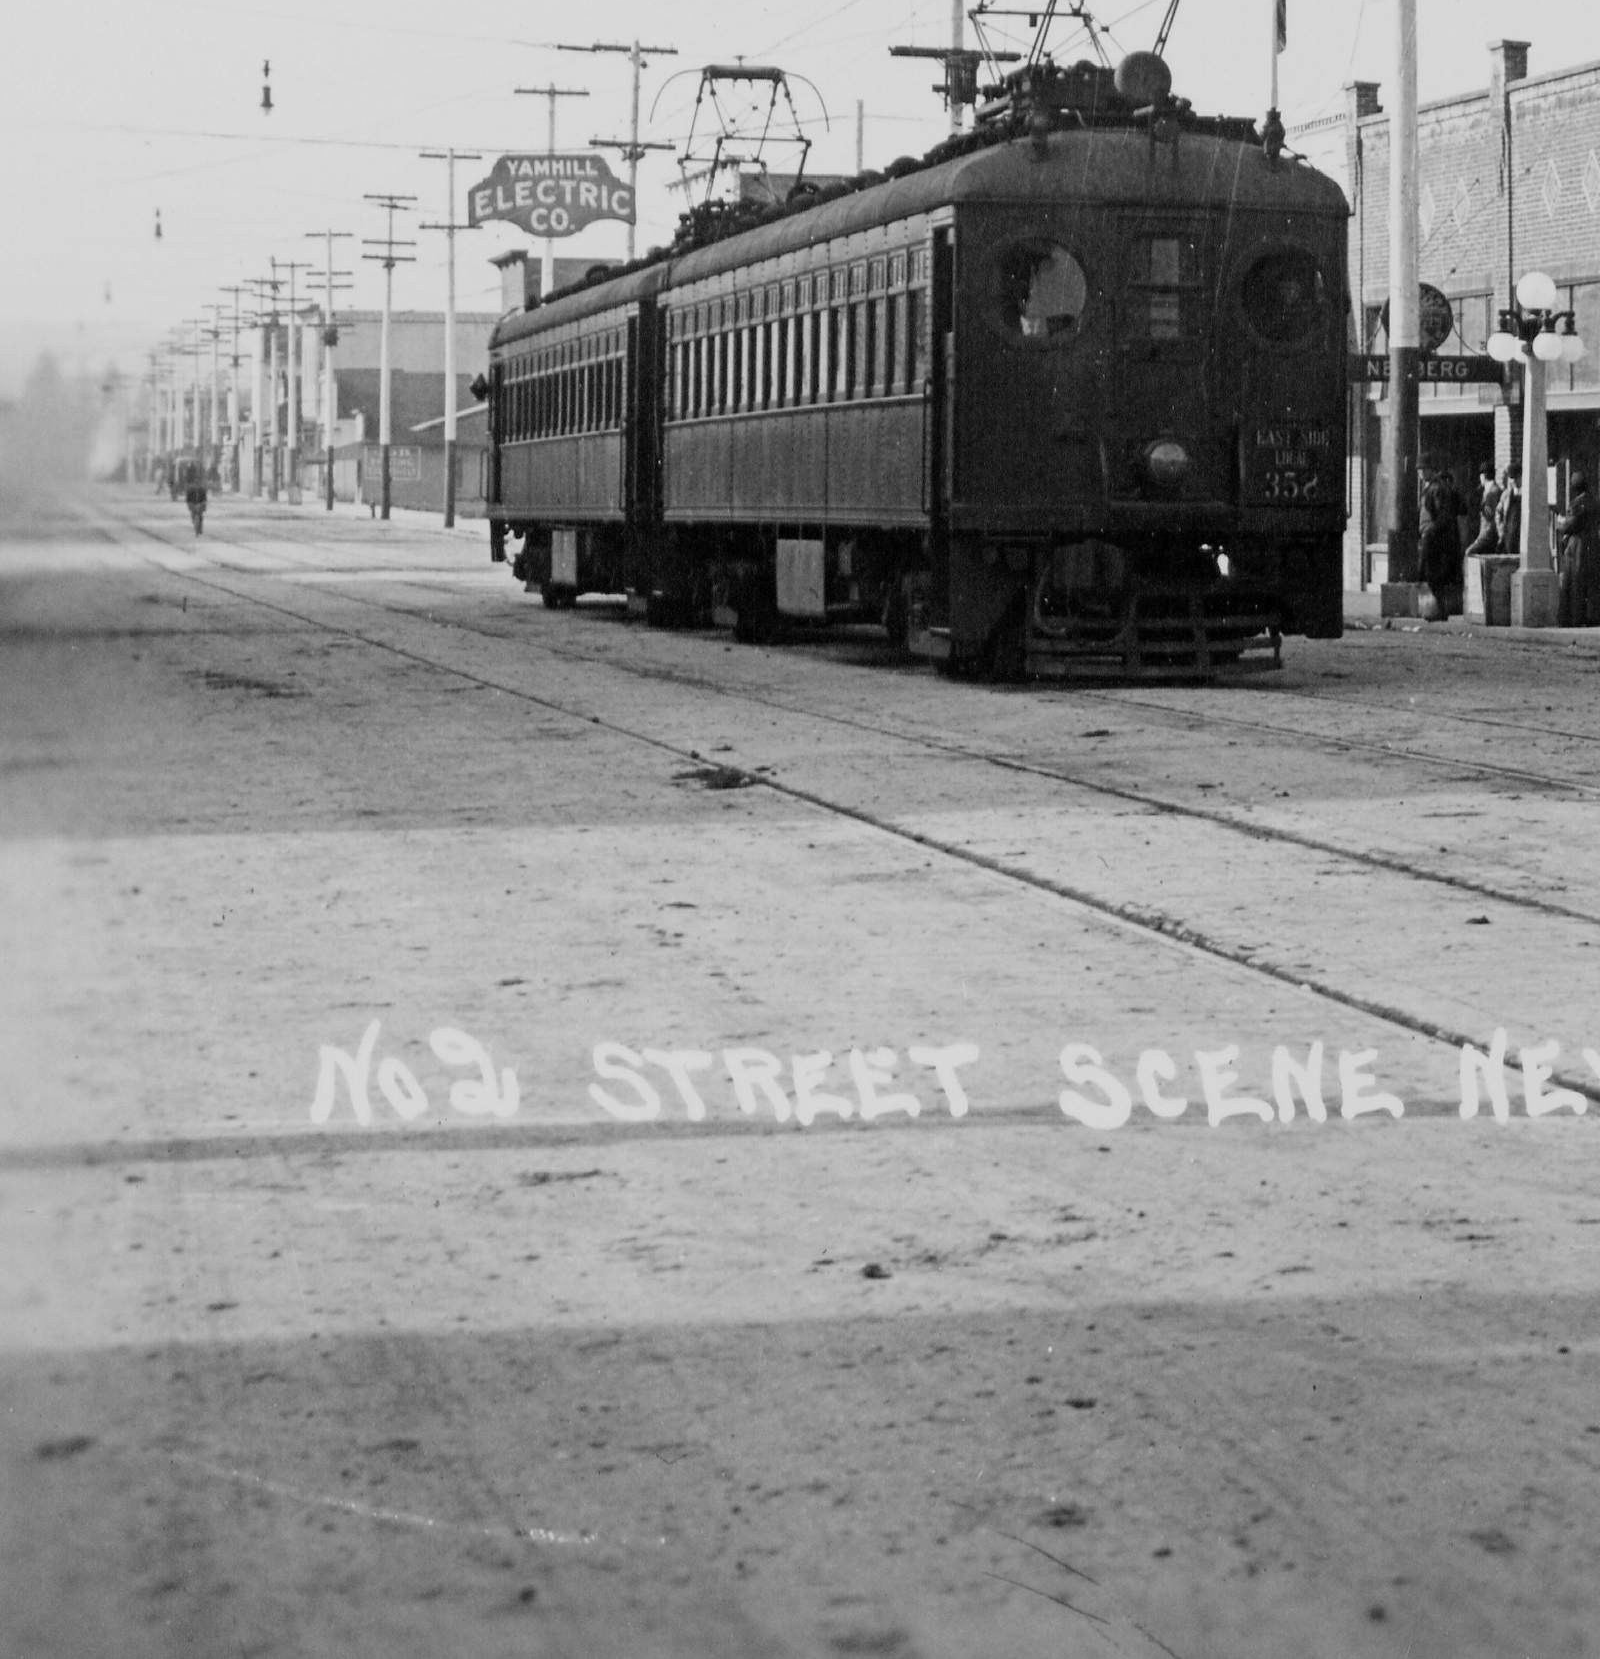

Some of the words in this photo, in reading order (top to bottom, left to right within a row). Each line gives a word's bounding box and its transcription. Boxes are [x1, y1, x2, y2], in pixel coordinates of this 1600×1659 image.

[506, 159, 598, 177] YAMHILL
[474, 178, 631, 219] ELECTRIC
[529, 206, 576, 231] CO.
[1366, 359, 1470, 378] NEBERG
